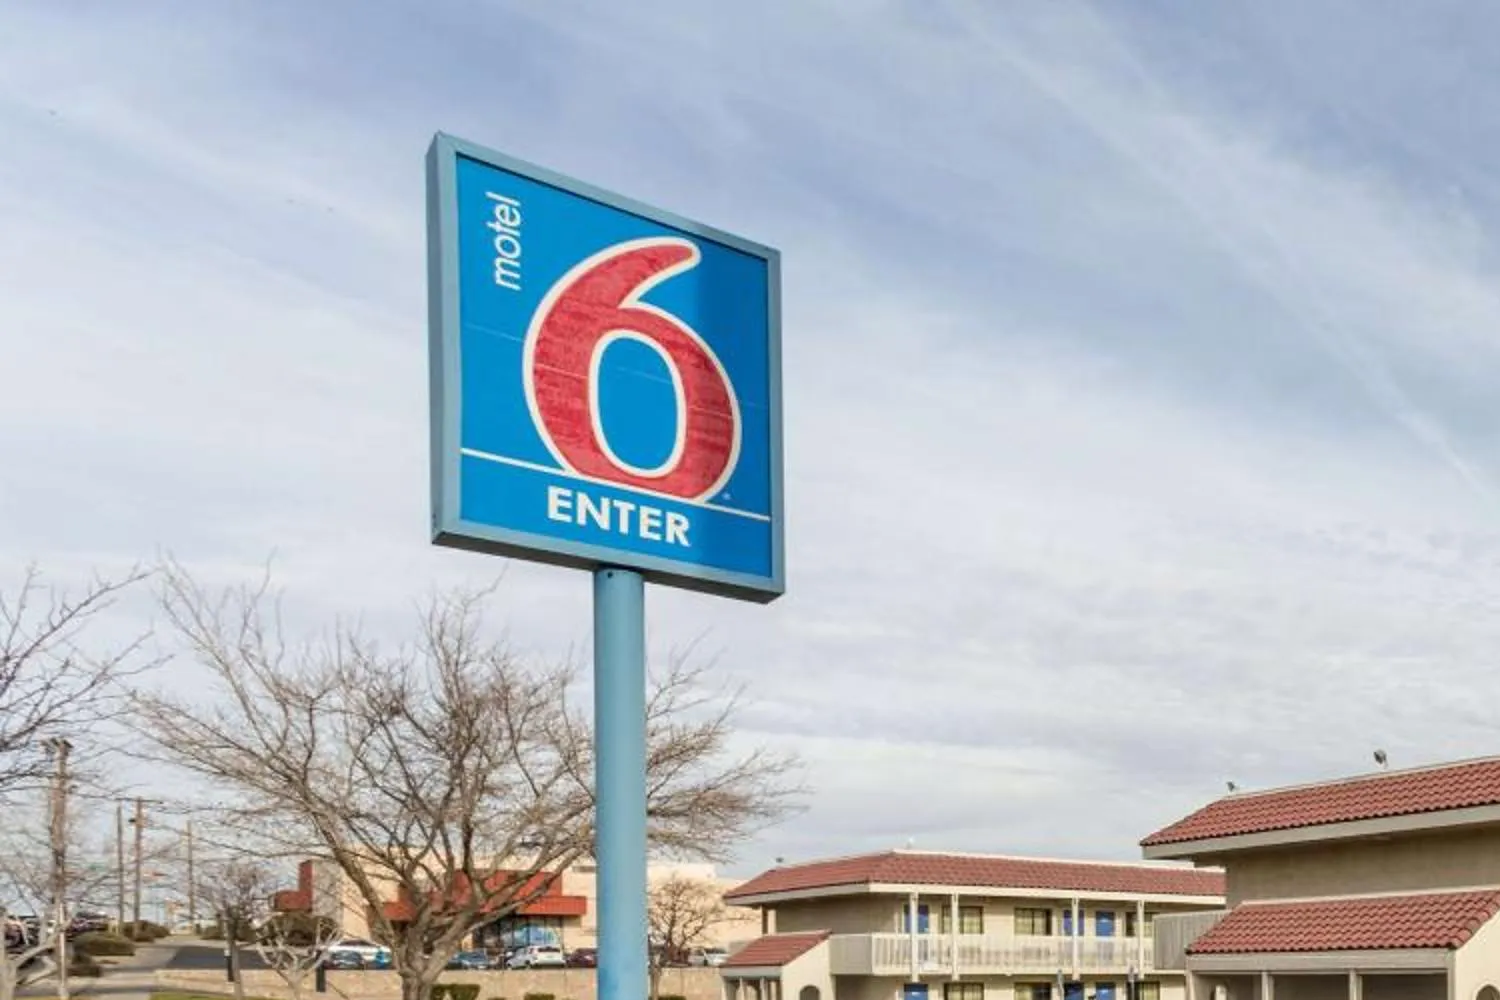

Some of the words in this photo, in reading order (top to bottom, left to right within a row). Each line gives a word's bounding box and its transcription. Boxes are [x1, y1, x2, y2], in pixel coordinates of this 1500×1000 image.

[485, 191, 521, 290] motel
[523, 238, 741, 504] 6
[548, 486, 691, 547] ENTER
